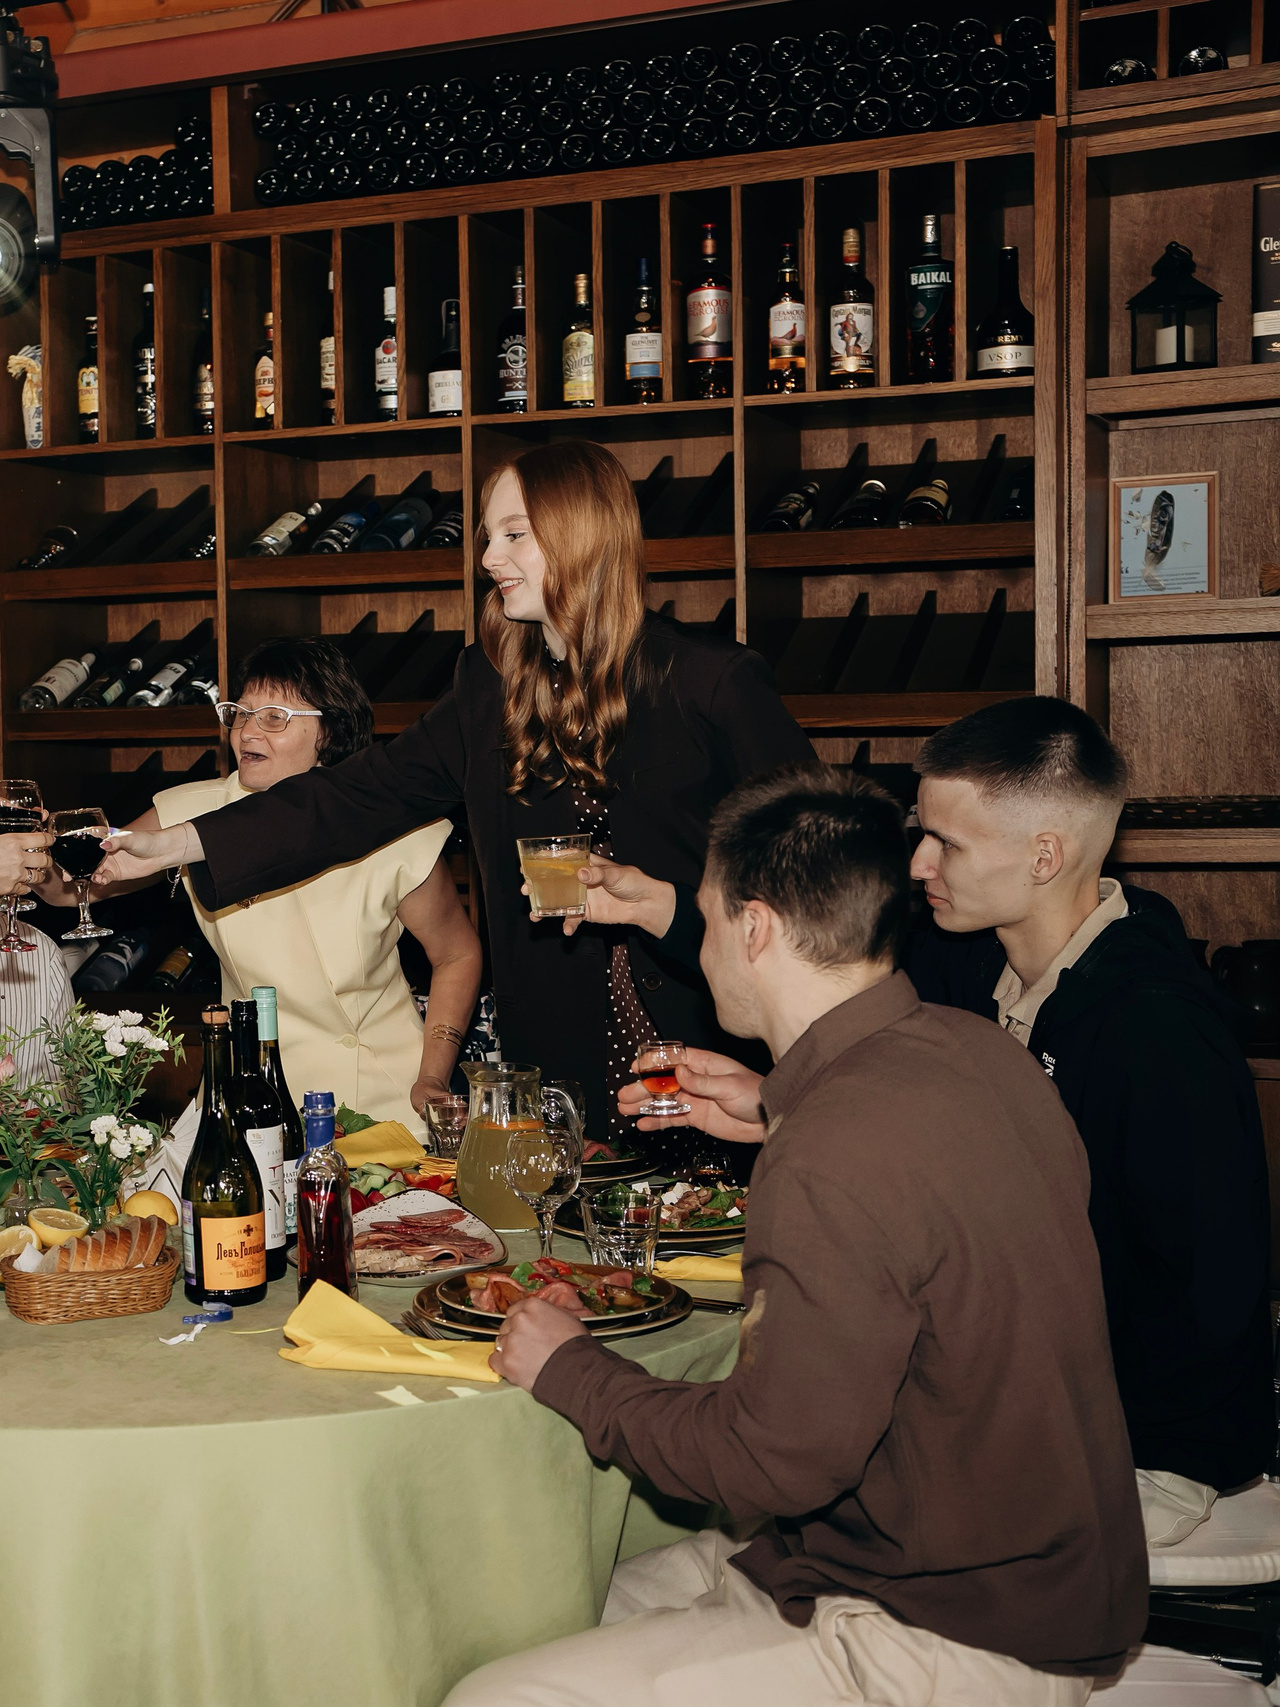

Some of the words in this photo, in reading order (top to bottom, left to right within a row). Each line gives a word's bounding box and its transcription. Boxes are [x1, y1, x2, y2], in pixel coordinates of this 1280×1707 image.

[910, 271, 952, 286] BAIKAL
[693, 298, 729, 309] FAMOUS
[852, 306, 872, 317] Morgan
[988, 351, 1022, 362] VSOP
[216, 1242, 239, 1260] Левъ
